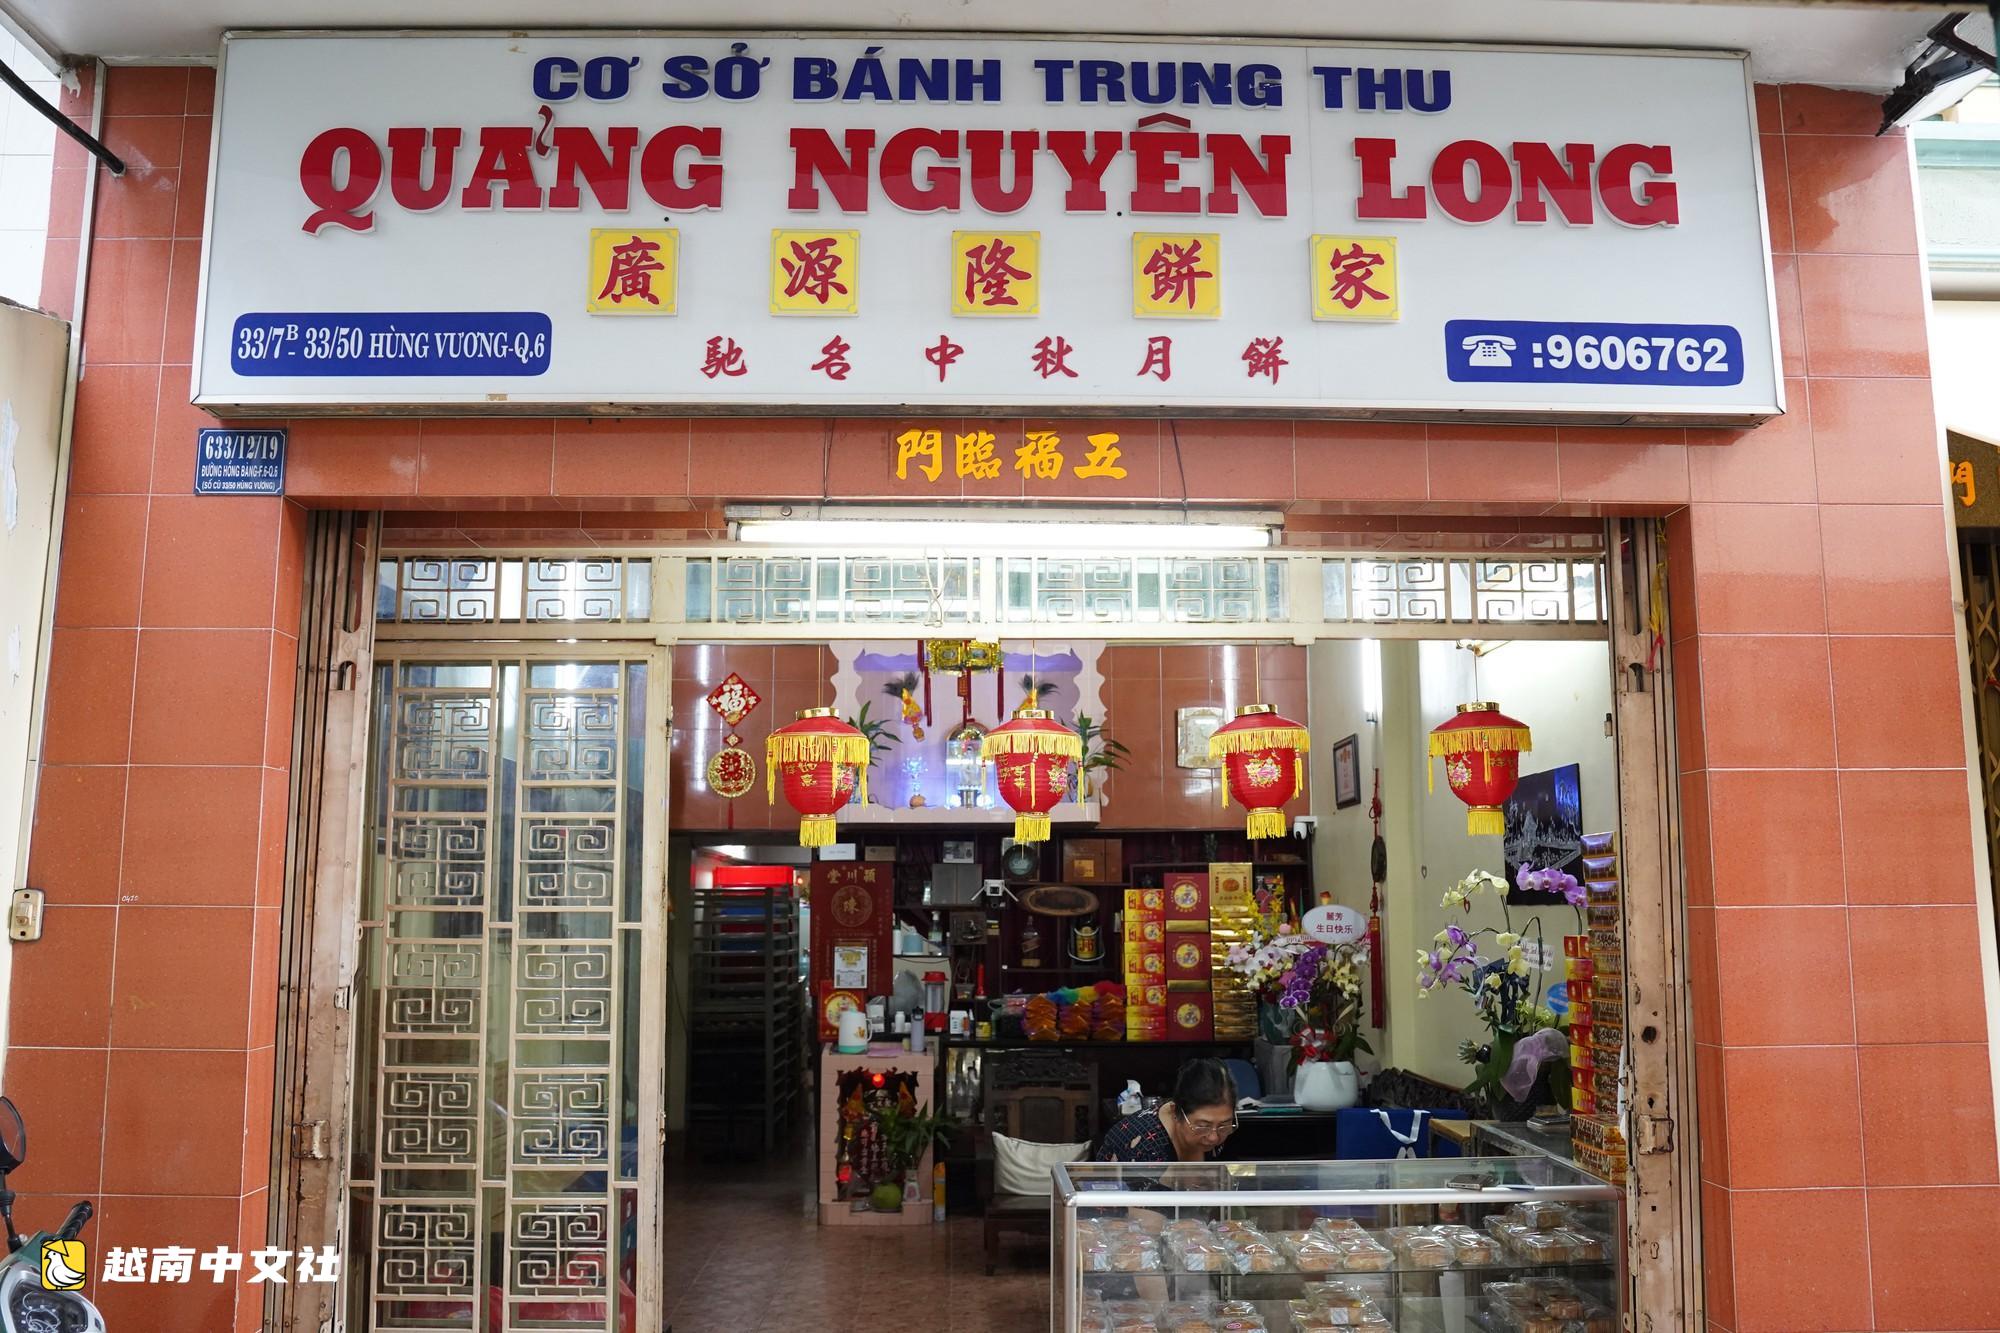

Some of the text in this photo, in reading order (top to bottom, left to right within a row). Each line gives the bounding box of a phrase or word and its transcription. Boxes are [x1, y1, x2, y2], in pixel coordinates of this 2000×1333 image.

[533, 42, 1453, 114] CƠ SỞ BÁNH TRUNG THU
[299, 103, 1680, 237] QUẢNG NGUYÊN LONG
[302, 326, 364, 360] 33/50
[367, 324, 430, 360] HÙNG
[205, 435, 279, 460] 633/12/19
[1316, 924, 1353, 934] 生日快乐
